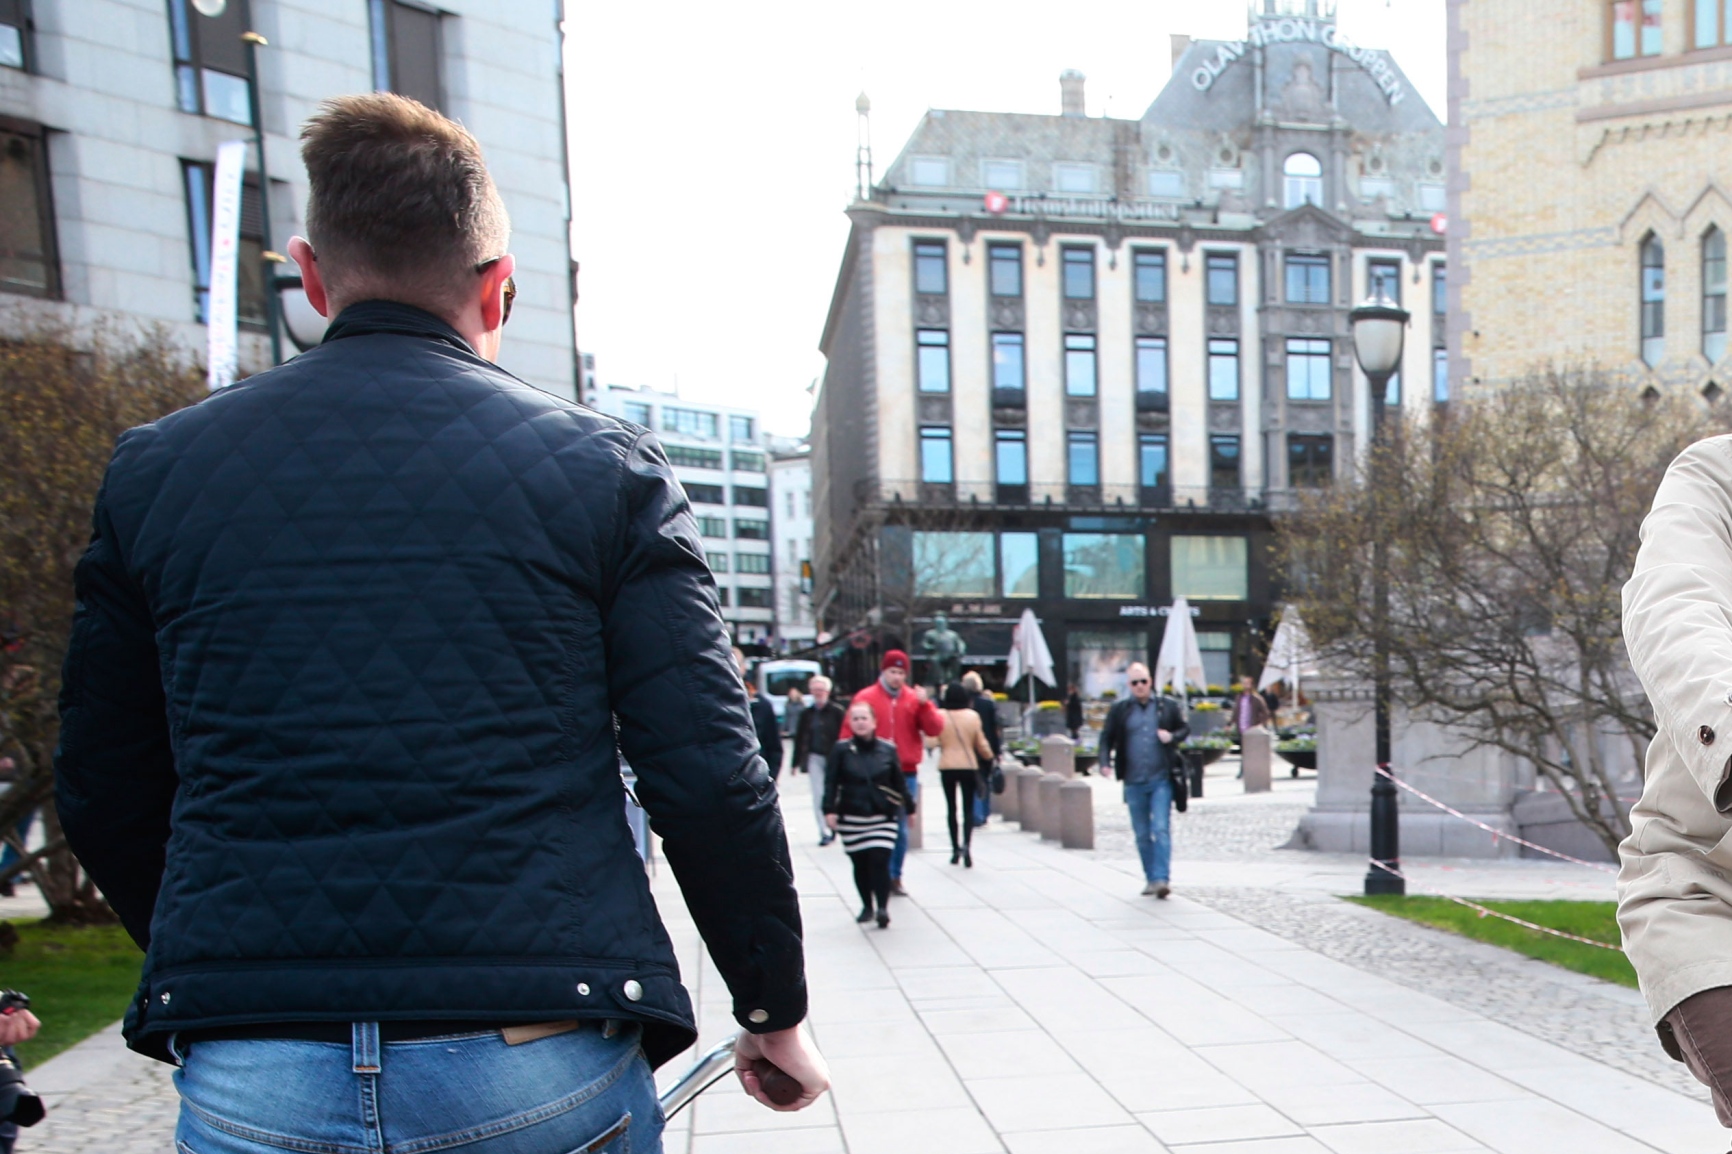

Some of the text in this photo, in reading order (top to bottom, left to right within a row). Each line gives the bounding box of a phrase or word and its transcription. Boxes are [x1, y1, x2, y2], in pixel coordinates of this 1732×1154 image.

[1192, 18, 1405, 106] OLAV THON GRUPPEN
[1119, 606, 1148, 617] ARTS
